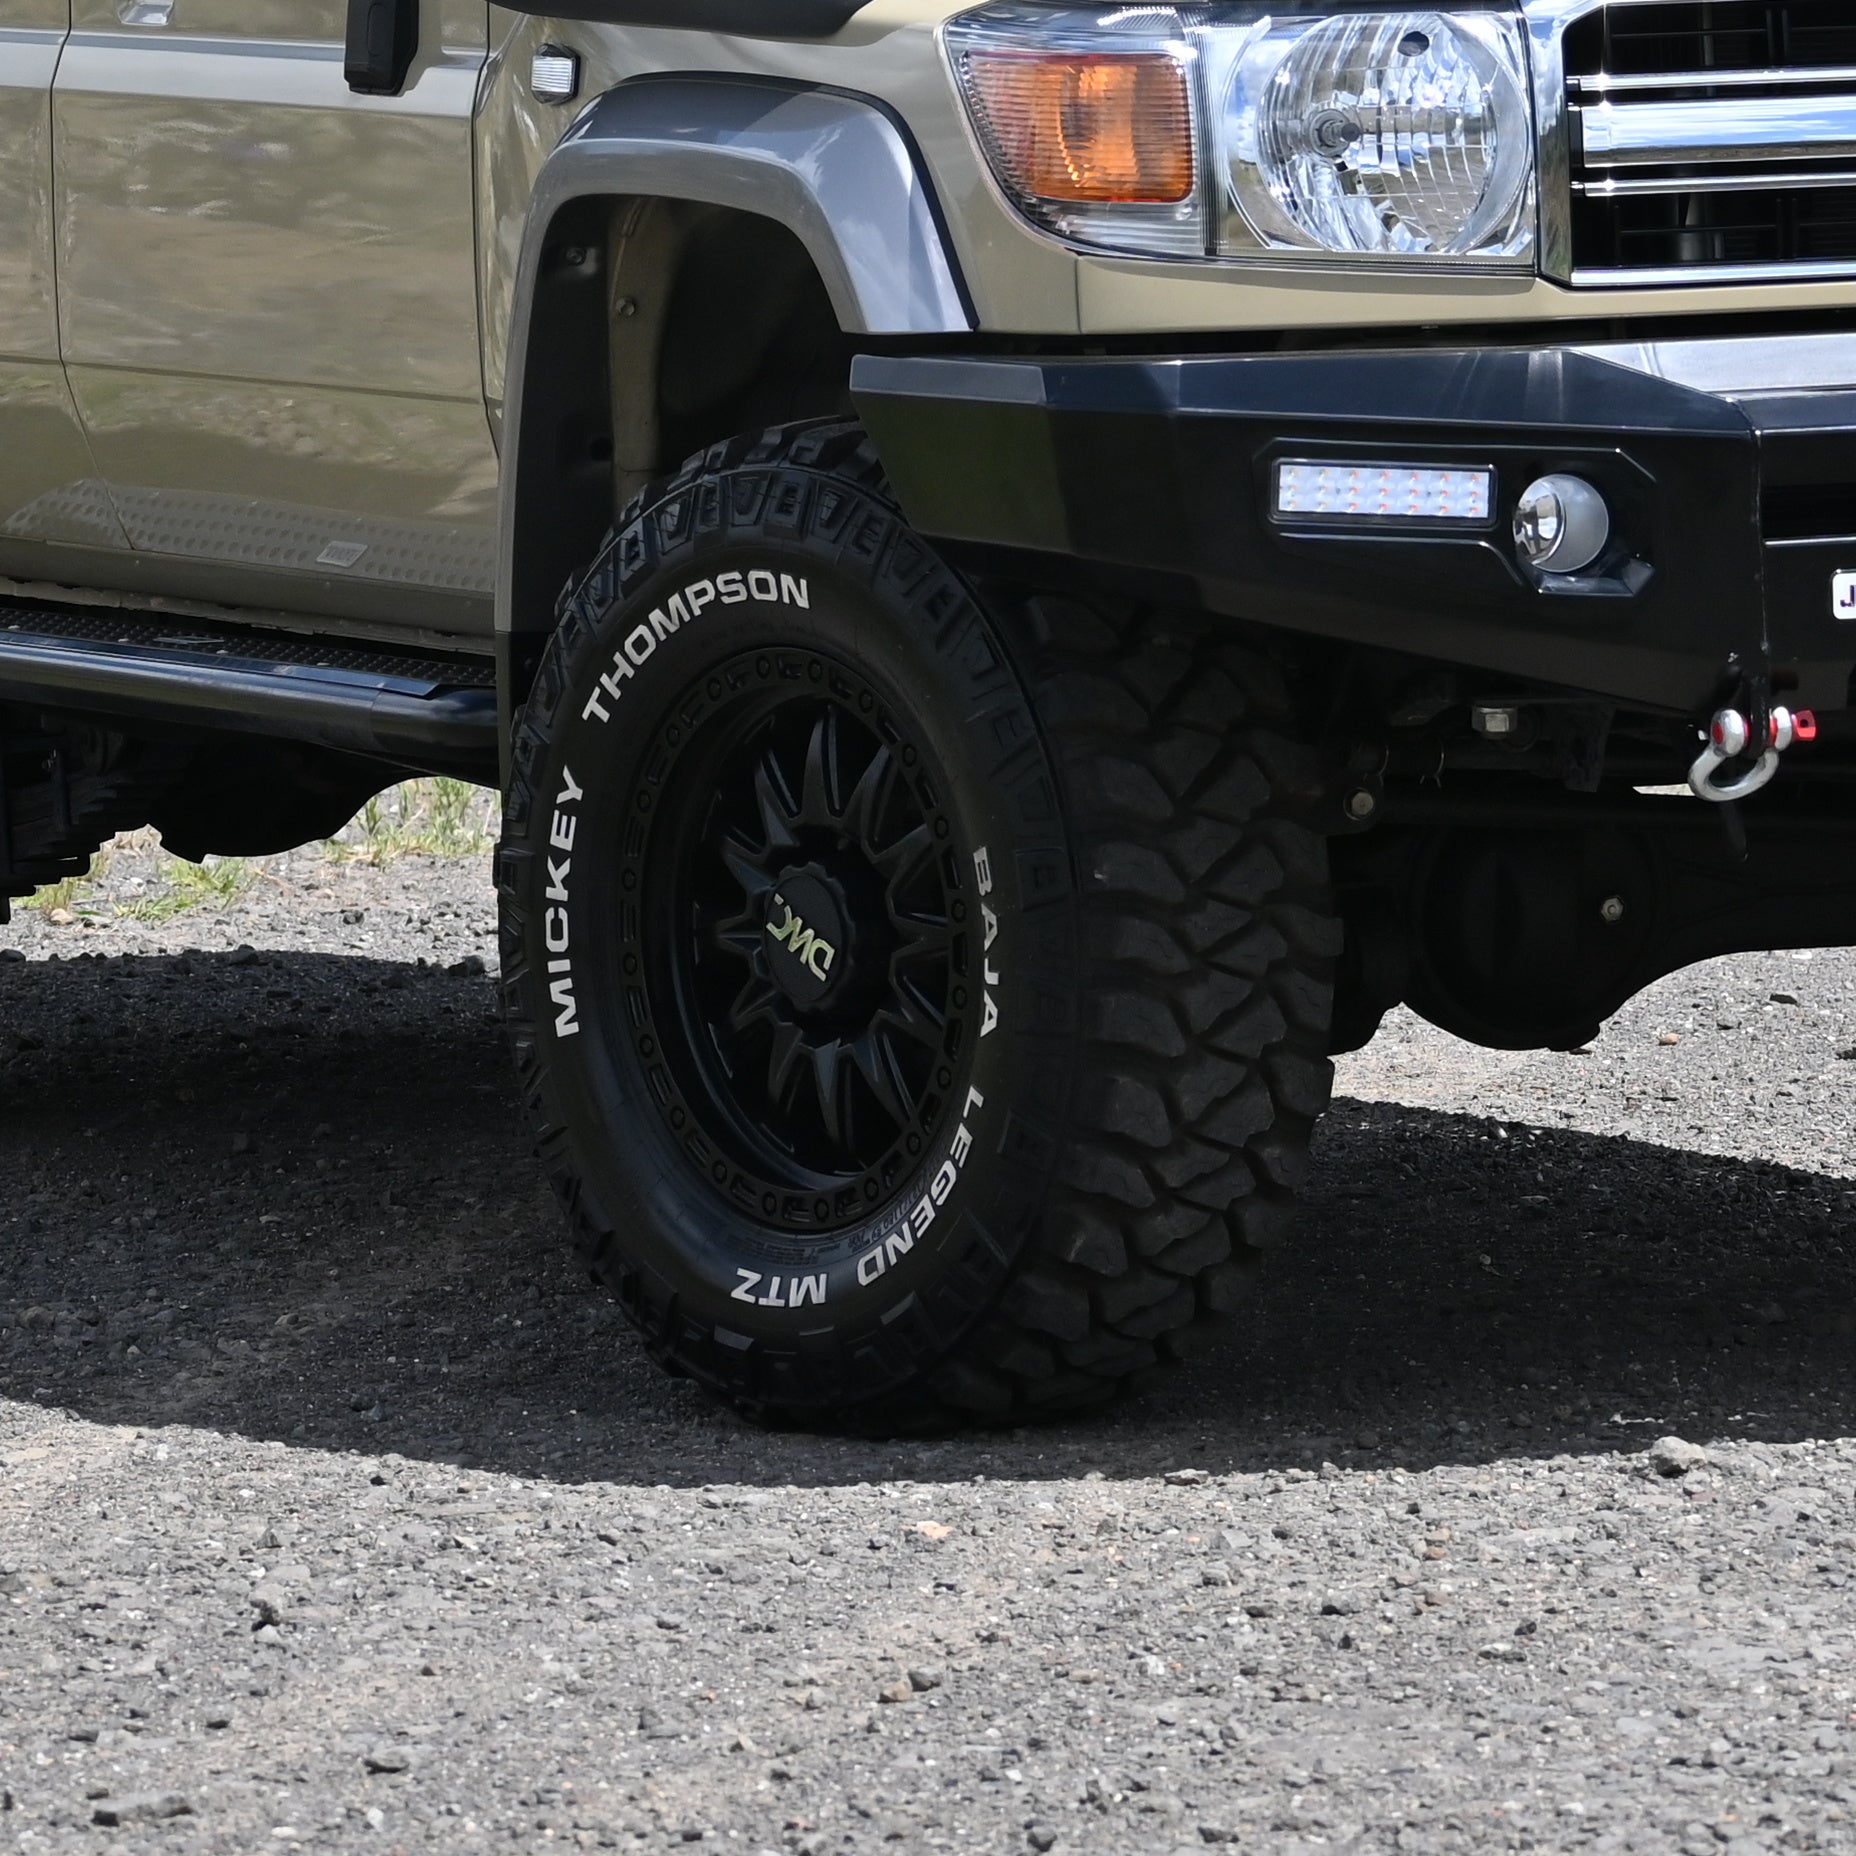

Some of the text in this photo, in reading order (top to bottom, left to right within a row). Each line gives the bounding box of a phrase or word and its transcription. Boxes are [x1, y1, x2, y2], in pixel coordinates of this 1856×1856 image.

[545, 570, 811, 1037] MICKEY THOMPSON
[973, 846, 999, 1037] BAJA
[857, 1085, 984, 1286] LEGEND
[730, 1267, 827, 1308] MTZ
